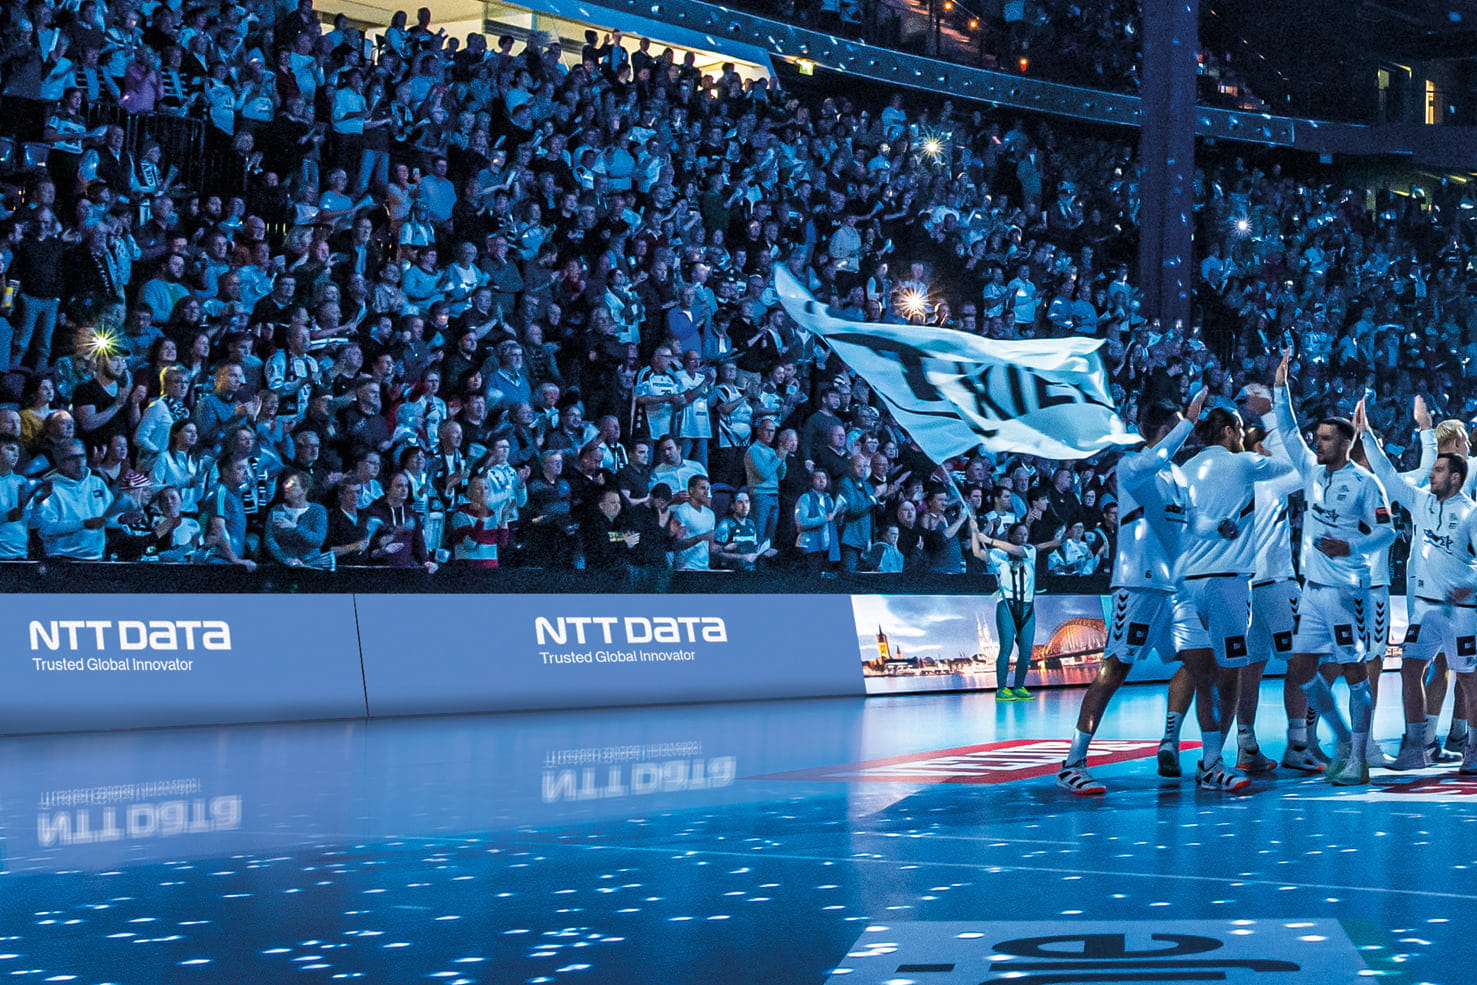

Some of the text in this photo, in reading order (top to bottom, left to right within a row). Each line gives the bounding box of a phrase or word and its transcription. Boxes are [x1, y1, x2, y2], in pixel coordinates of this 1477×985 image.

[29, 620, 112, 651] NTT
[535, 616, 618, 646] NTT
[32, 657, 193, 671] Trusted Global Innovator
[540, 649, 696, 664] Trusted Global Innovator
